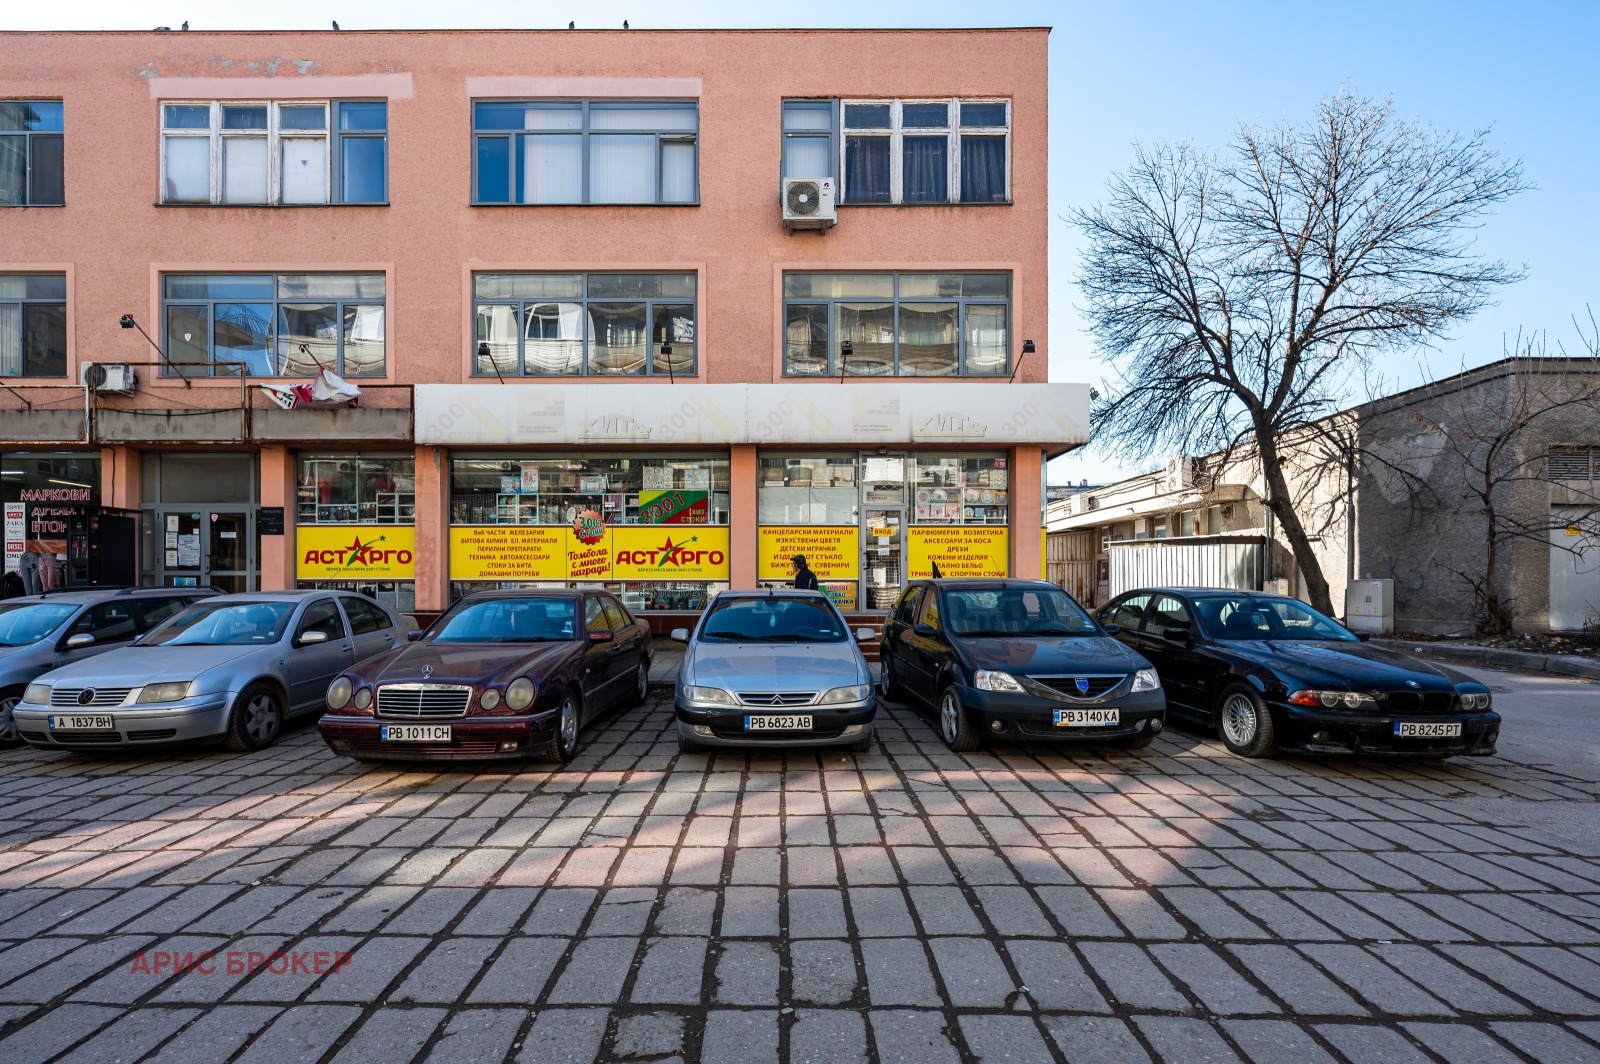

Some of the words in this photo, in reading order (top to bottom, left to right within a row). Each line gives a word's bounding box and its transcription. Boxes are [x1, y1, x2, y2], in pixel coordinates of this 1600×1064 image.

[20, 489, 90, 501] МАРКОВИ
[640, 492, 684, 524] 3001
[579, 517, 602, 528] 3001
[580, 528, 603, 538] СТОКИ
[568, 549, 608, 560] Томбола
[579, 557, 607, 567] много
[571, 562, 610, 577] награди!
[59, 718, 65, 727] A
[71, 718, 94, 727] 1837
[96, 717, 110, 727] BH
[1061, 712, 1075, 722] PB
[1077, 712, 1102, 722] 3140
[1104, 711, 1117, 722] KA
[751, 718, 765, 728] PB
[768, 718, 794, 728] 6823
[797, 717, 810, 728] AB
[388, 728, 403, 738] PB
[406, 728, 431, 738] 1011
[434, 728, 449, 738] CH
[1401, 725, 1416, 735] PB
[1419, 725, 1444, 735] 8245
[1446, 725, 1460, 735] PT
